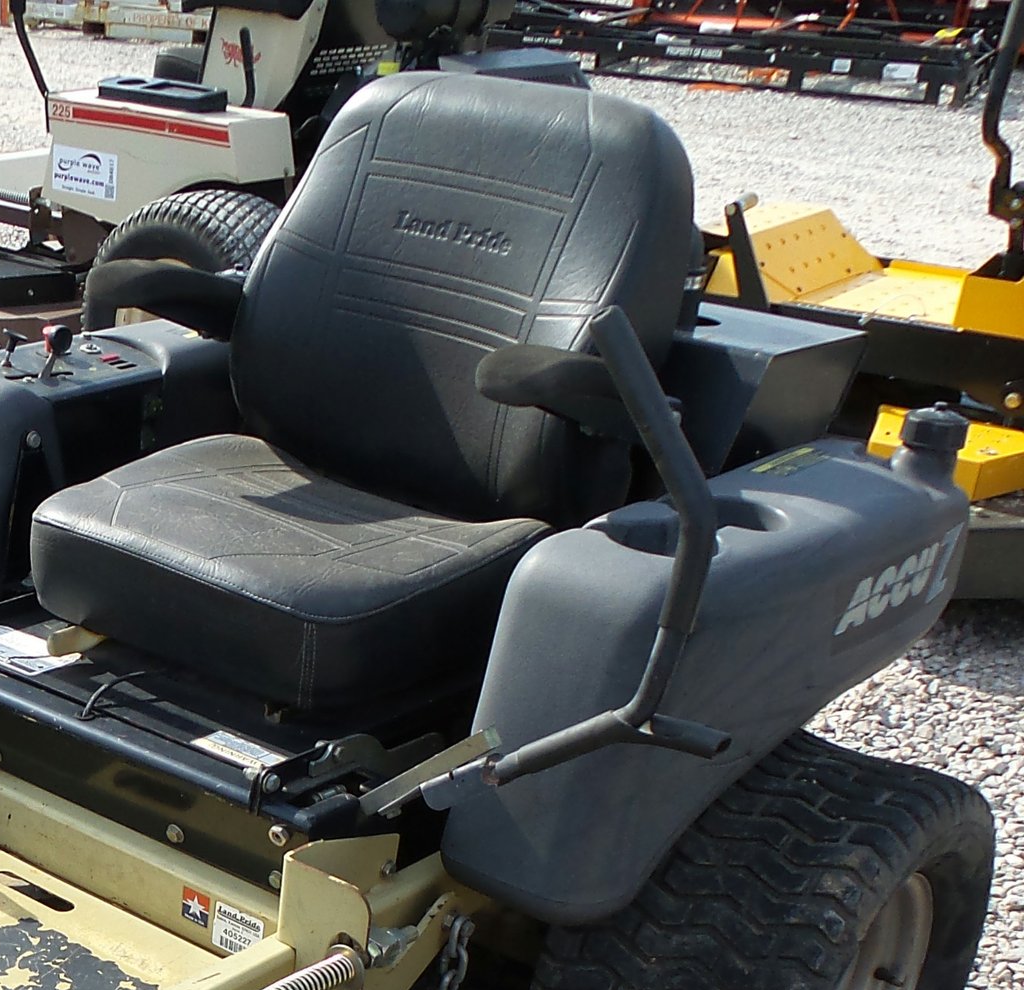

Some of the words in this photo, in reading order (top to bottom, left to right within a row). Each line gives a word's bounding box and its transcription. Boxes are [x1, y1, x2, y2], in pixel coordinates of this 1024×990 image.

[52, 103, 71, 118] 225
[54, 172, 105, 187] purplewave.com
[392, 209, 454, 241] Land
[453, 222, 513, 257] Pride
[217, 905, 237, 921] Land
[240, 915, 262, 933] Pride
[223, 928, 251, 948] 405227
